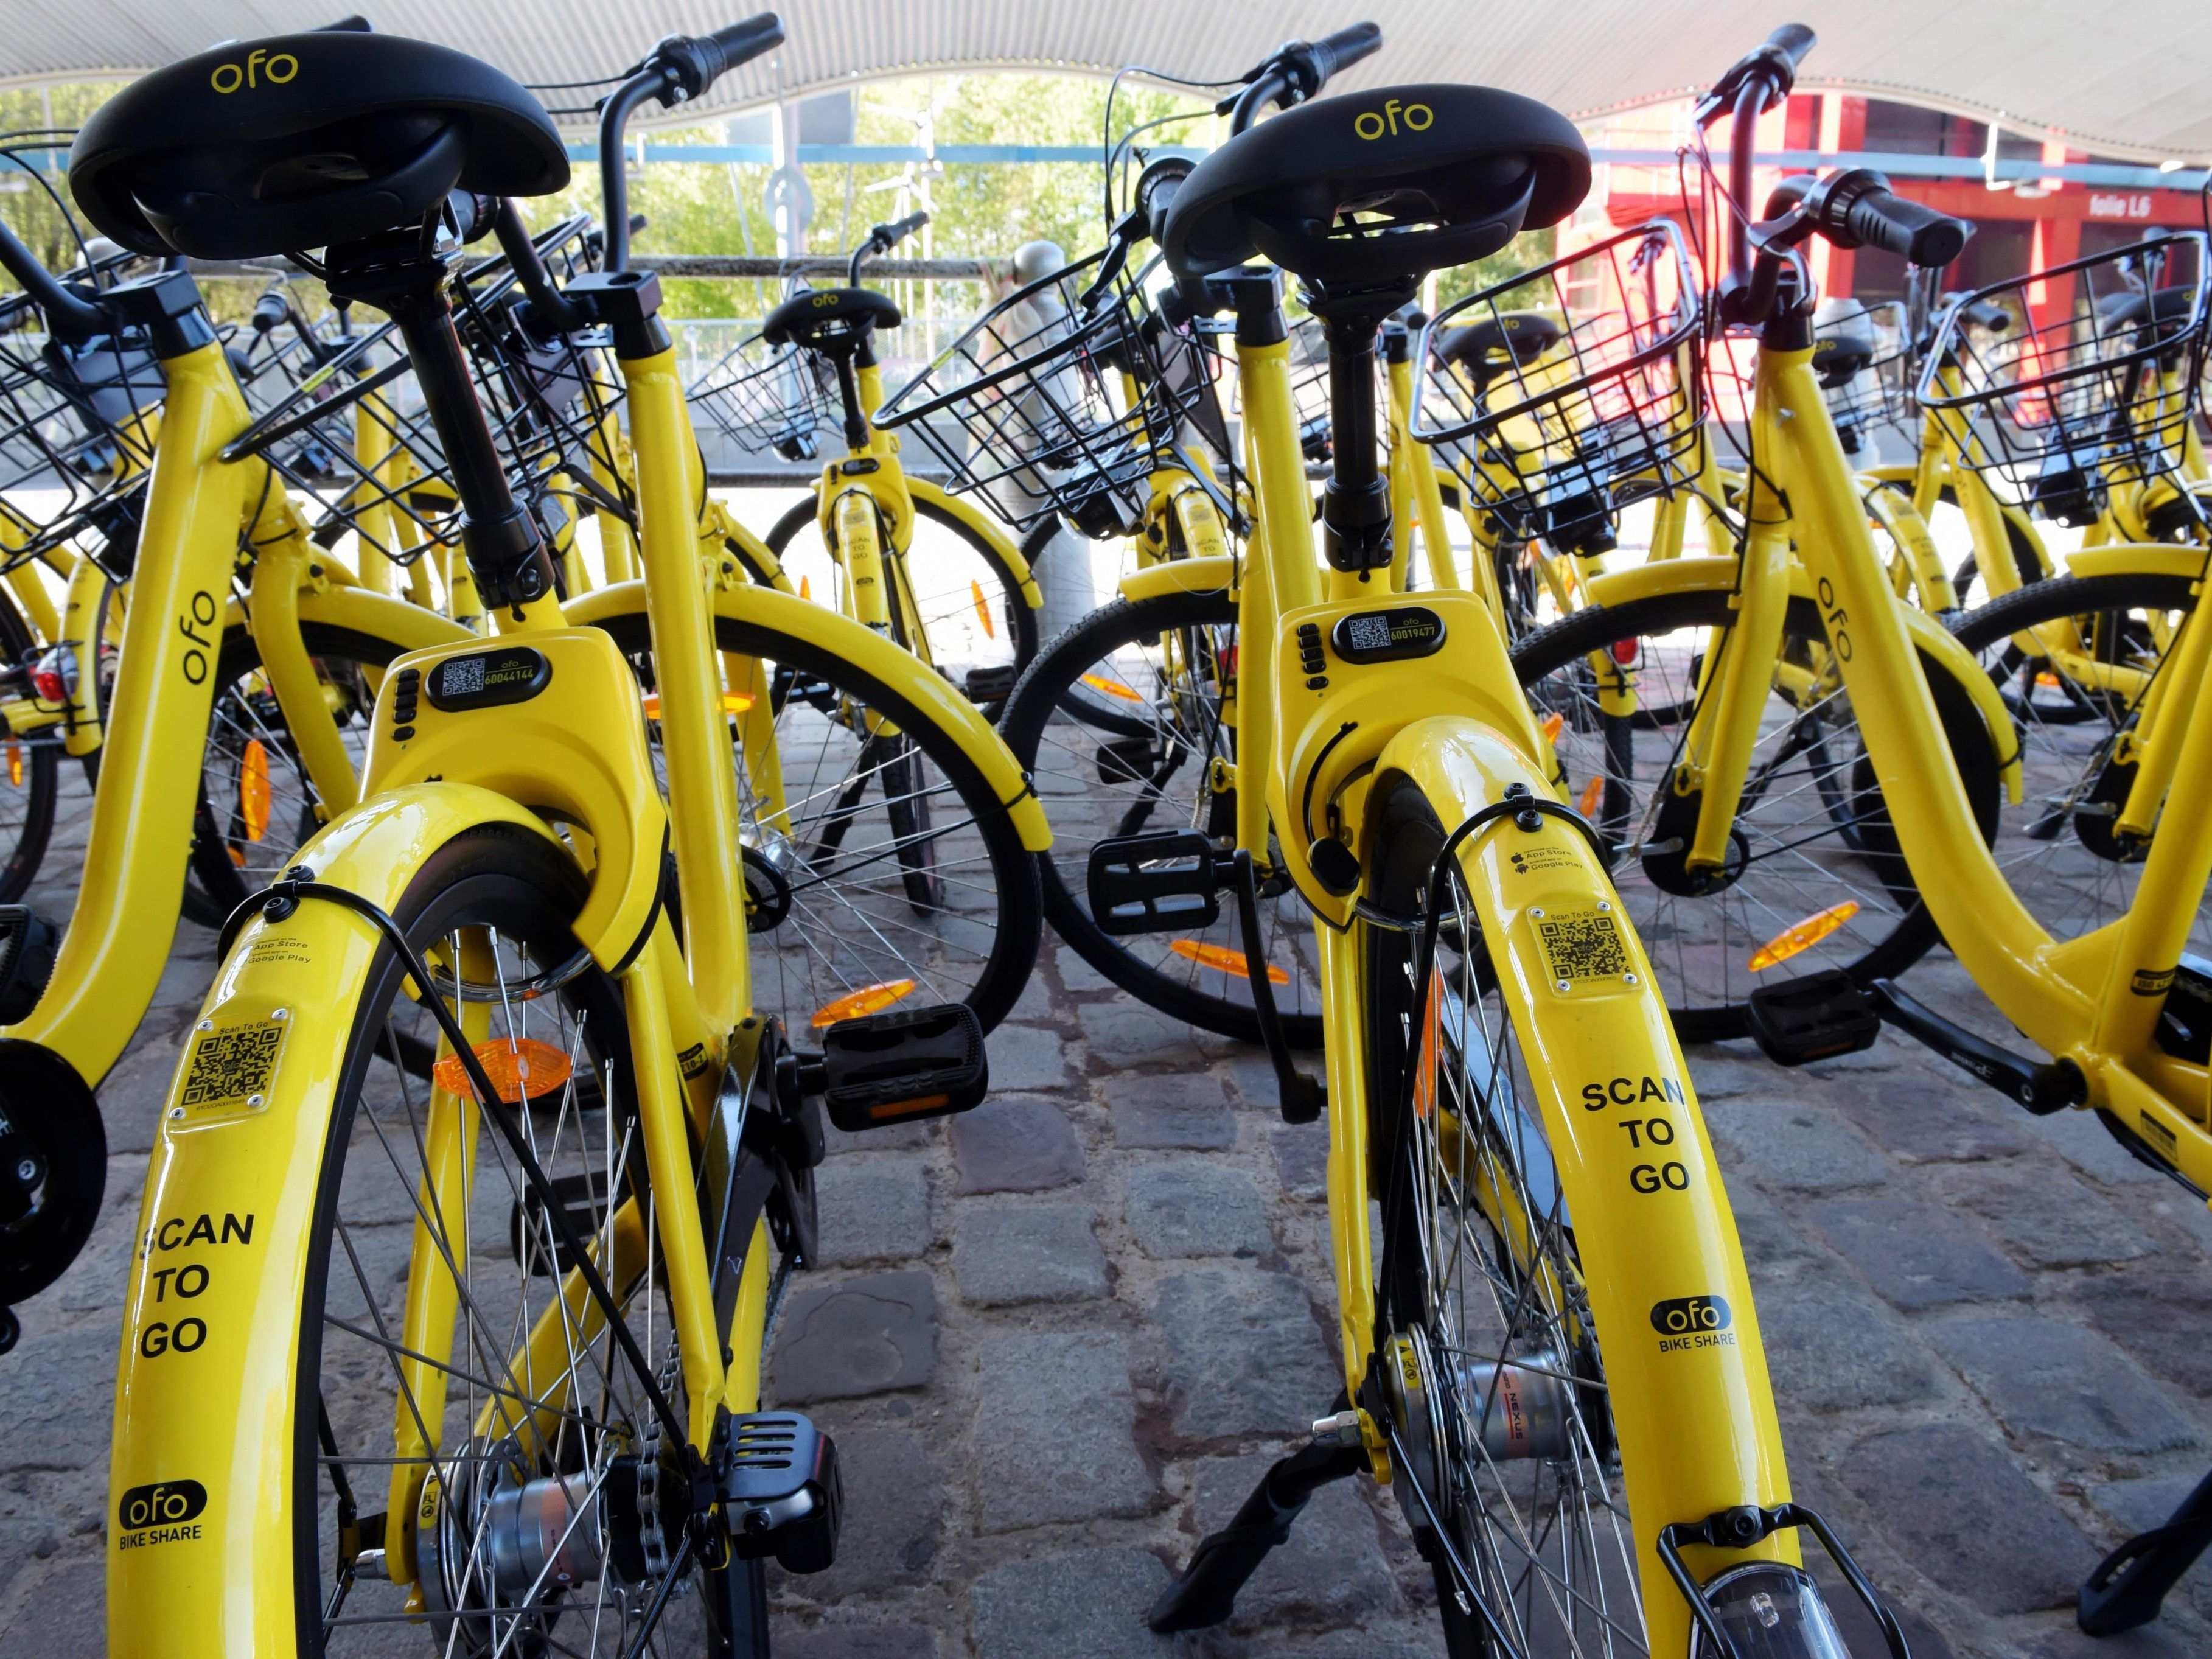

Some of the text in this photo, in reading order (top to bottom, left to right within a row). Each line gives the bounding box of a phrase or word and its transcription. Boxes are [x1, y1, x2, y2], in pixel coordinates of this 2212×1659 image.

[211, 49, 298, 94] ofo
[1355, 99, 1434, 141] ofo
[812, 293, 839, 308] ofo
[1390, 626, 1436, 641] 60019477
[1818, 576, 1852, 660] ofo
[179, 590, 216, 685] ofo
[484, 668, 534, 685] 60044144
[501, 660, 519, 669] ofo
[1531, 861, 1563, 870] Google
[248, 954, 311, 964] Google Play
[1582, 1076, 1685, 1112] SCAN
[1619, 1117, 1675, 1148] TO
[1630, 1161, 1690, 1194] GO
[139, 1213, 255, 1260] SCAN
[152, 1264, 210, 1304] TO
[1666, 1299, 1720, 1332] ofo
[141, 1317, 207, 1359] GO
[1659, 1333, 1736, 1353] BIKE SHARE
[1509, 1392, 1523, 1439] NEXUS
[129, 1486, 187, 1525] ofo
[119, 1525, 203, 1551] BIKE SHARE
